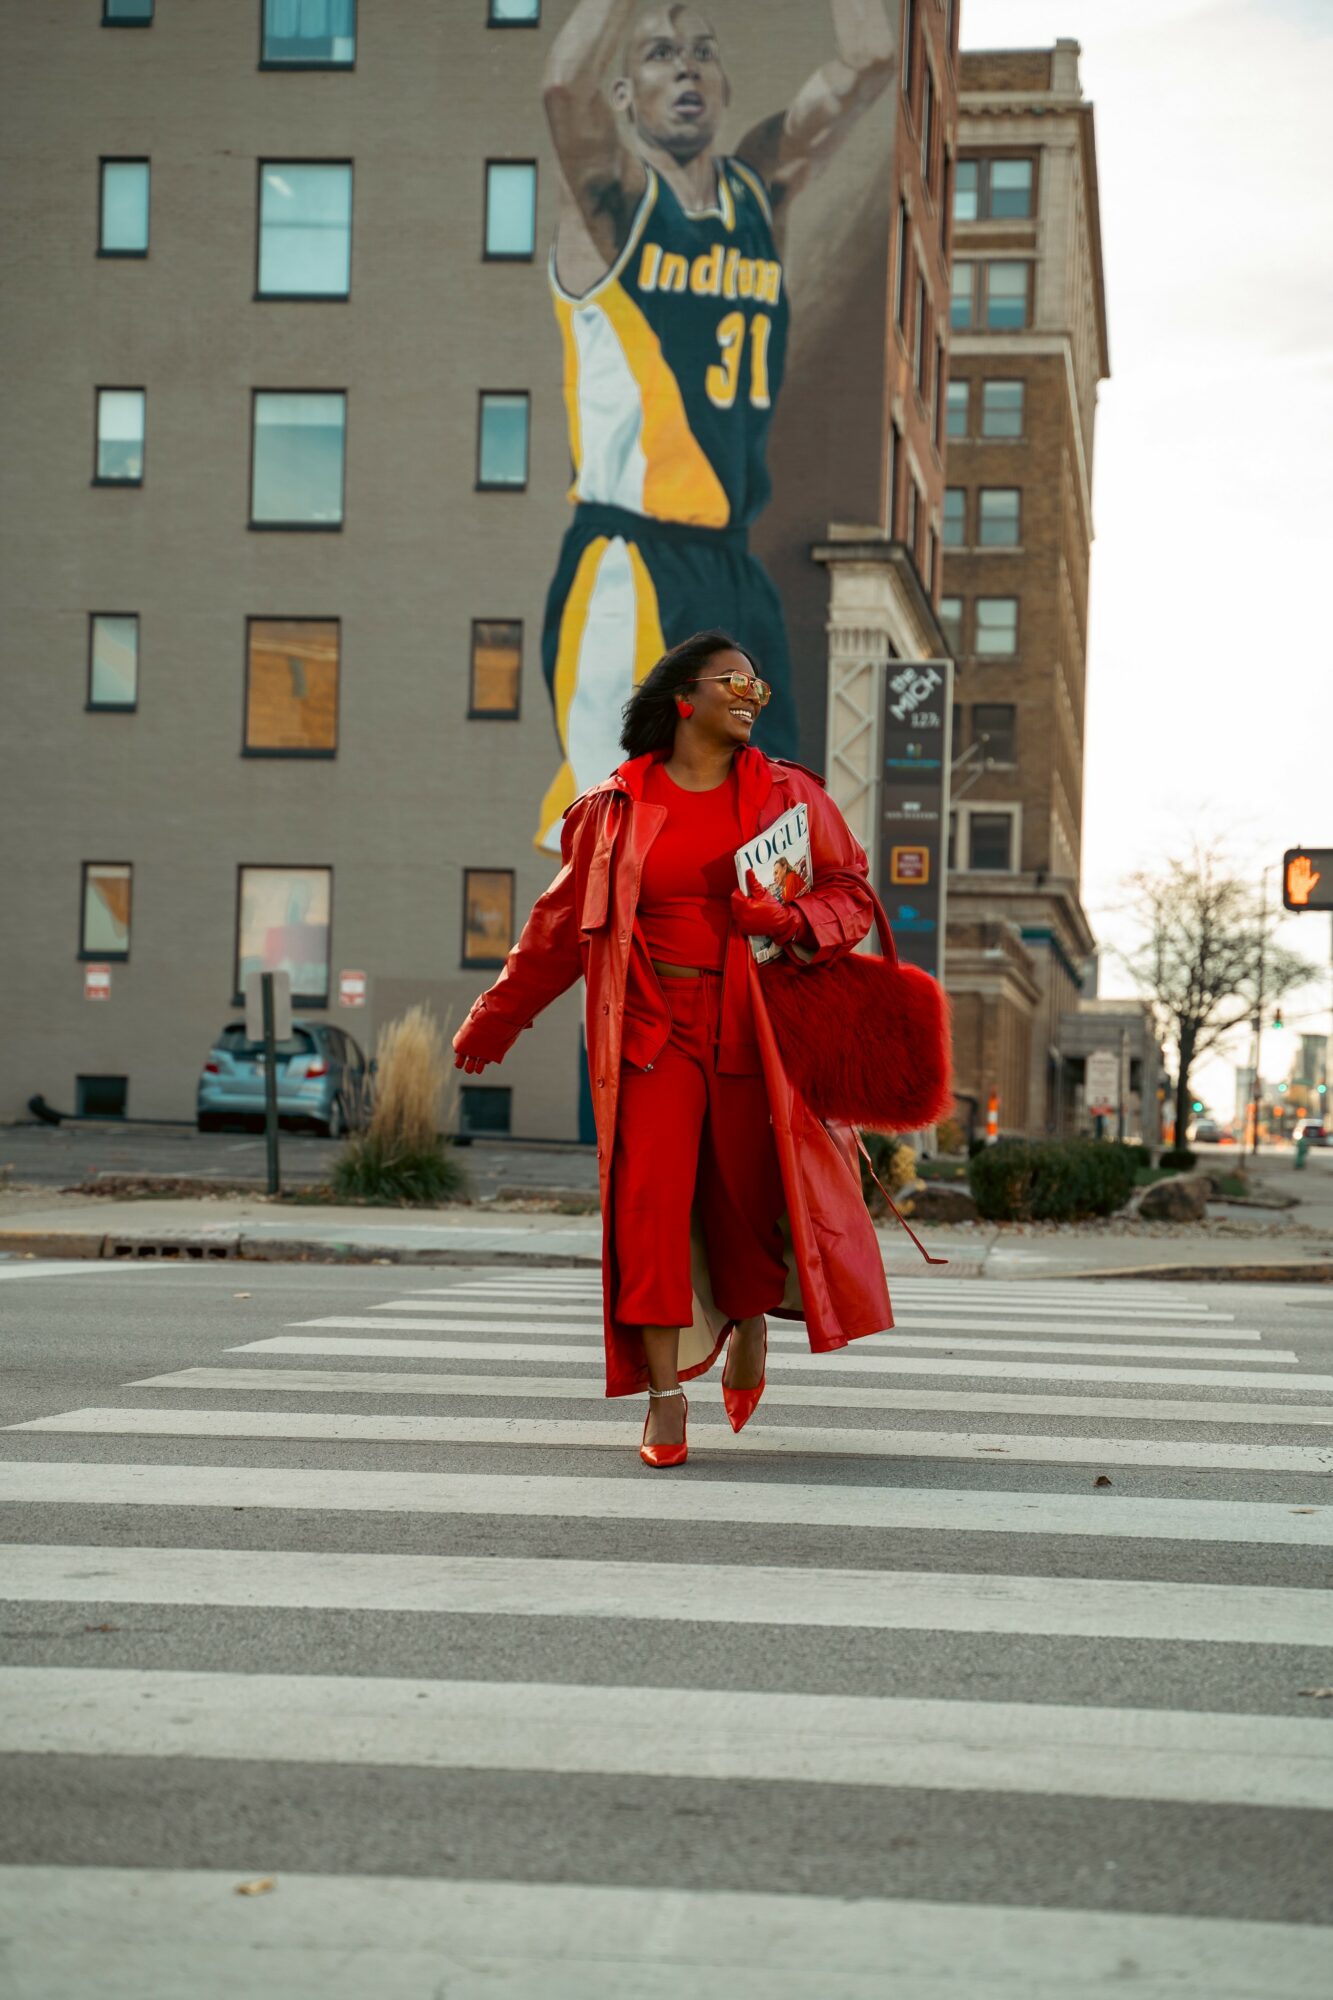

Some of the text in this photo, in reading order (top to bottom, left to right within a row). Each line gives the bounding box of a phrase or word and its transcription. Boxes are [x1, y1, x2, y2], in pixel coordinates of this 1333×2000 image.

[705, 311, 771, 409] 31
[889, 667, 943, 721] MICH
[744, 810, 808, 868] VOGUE
